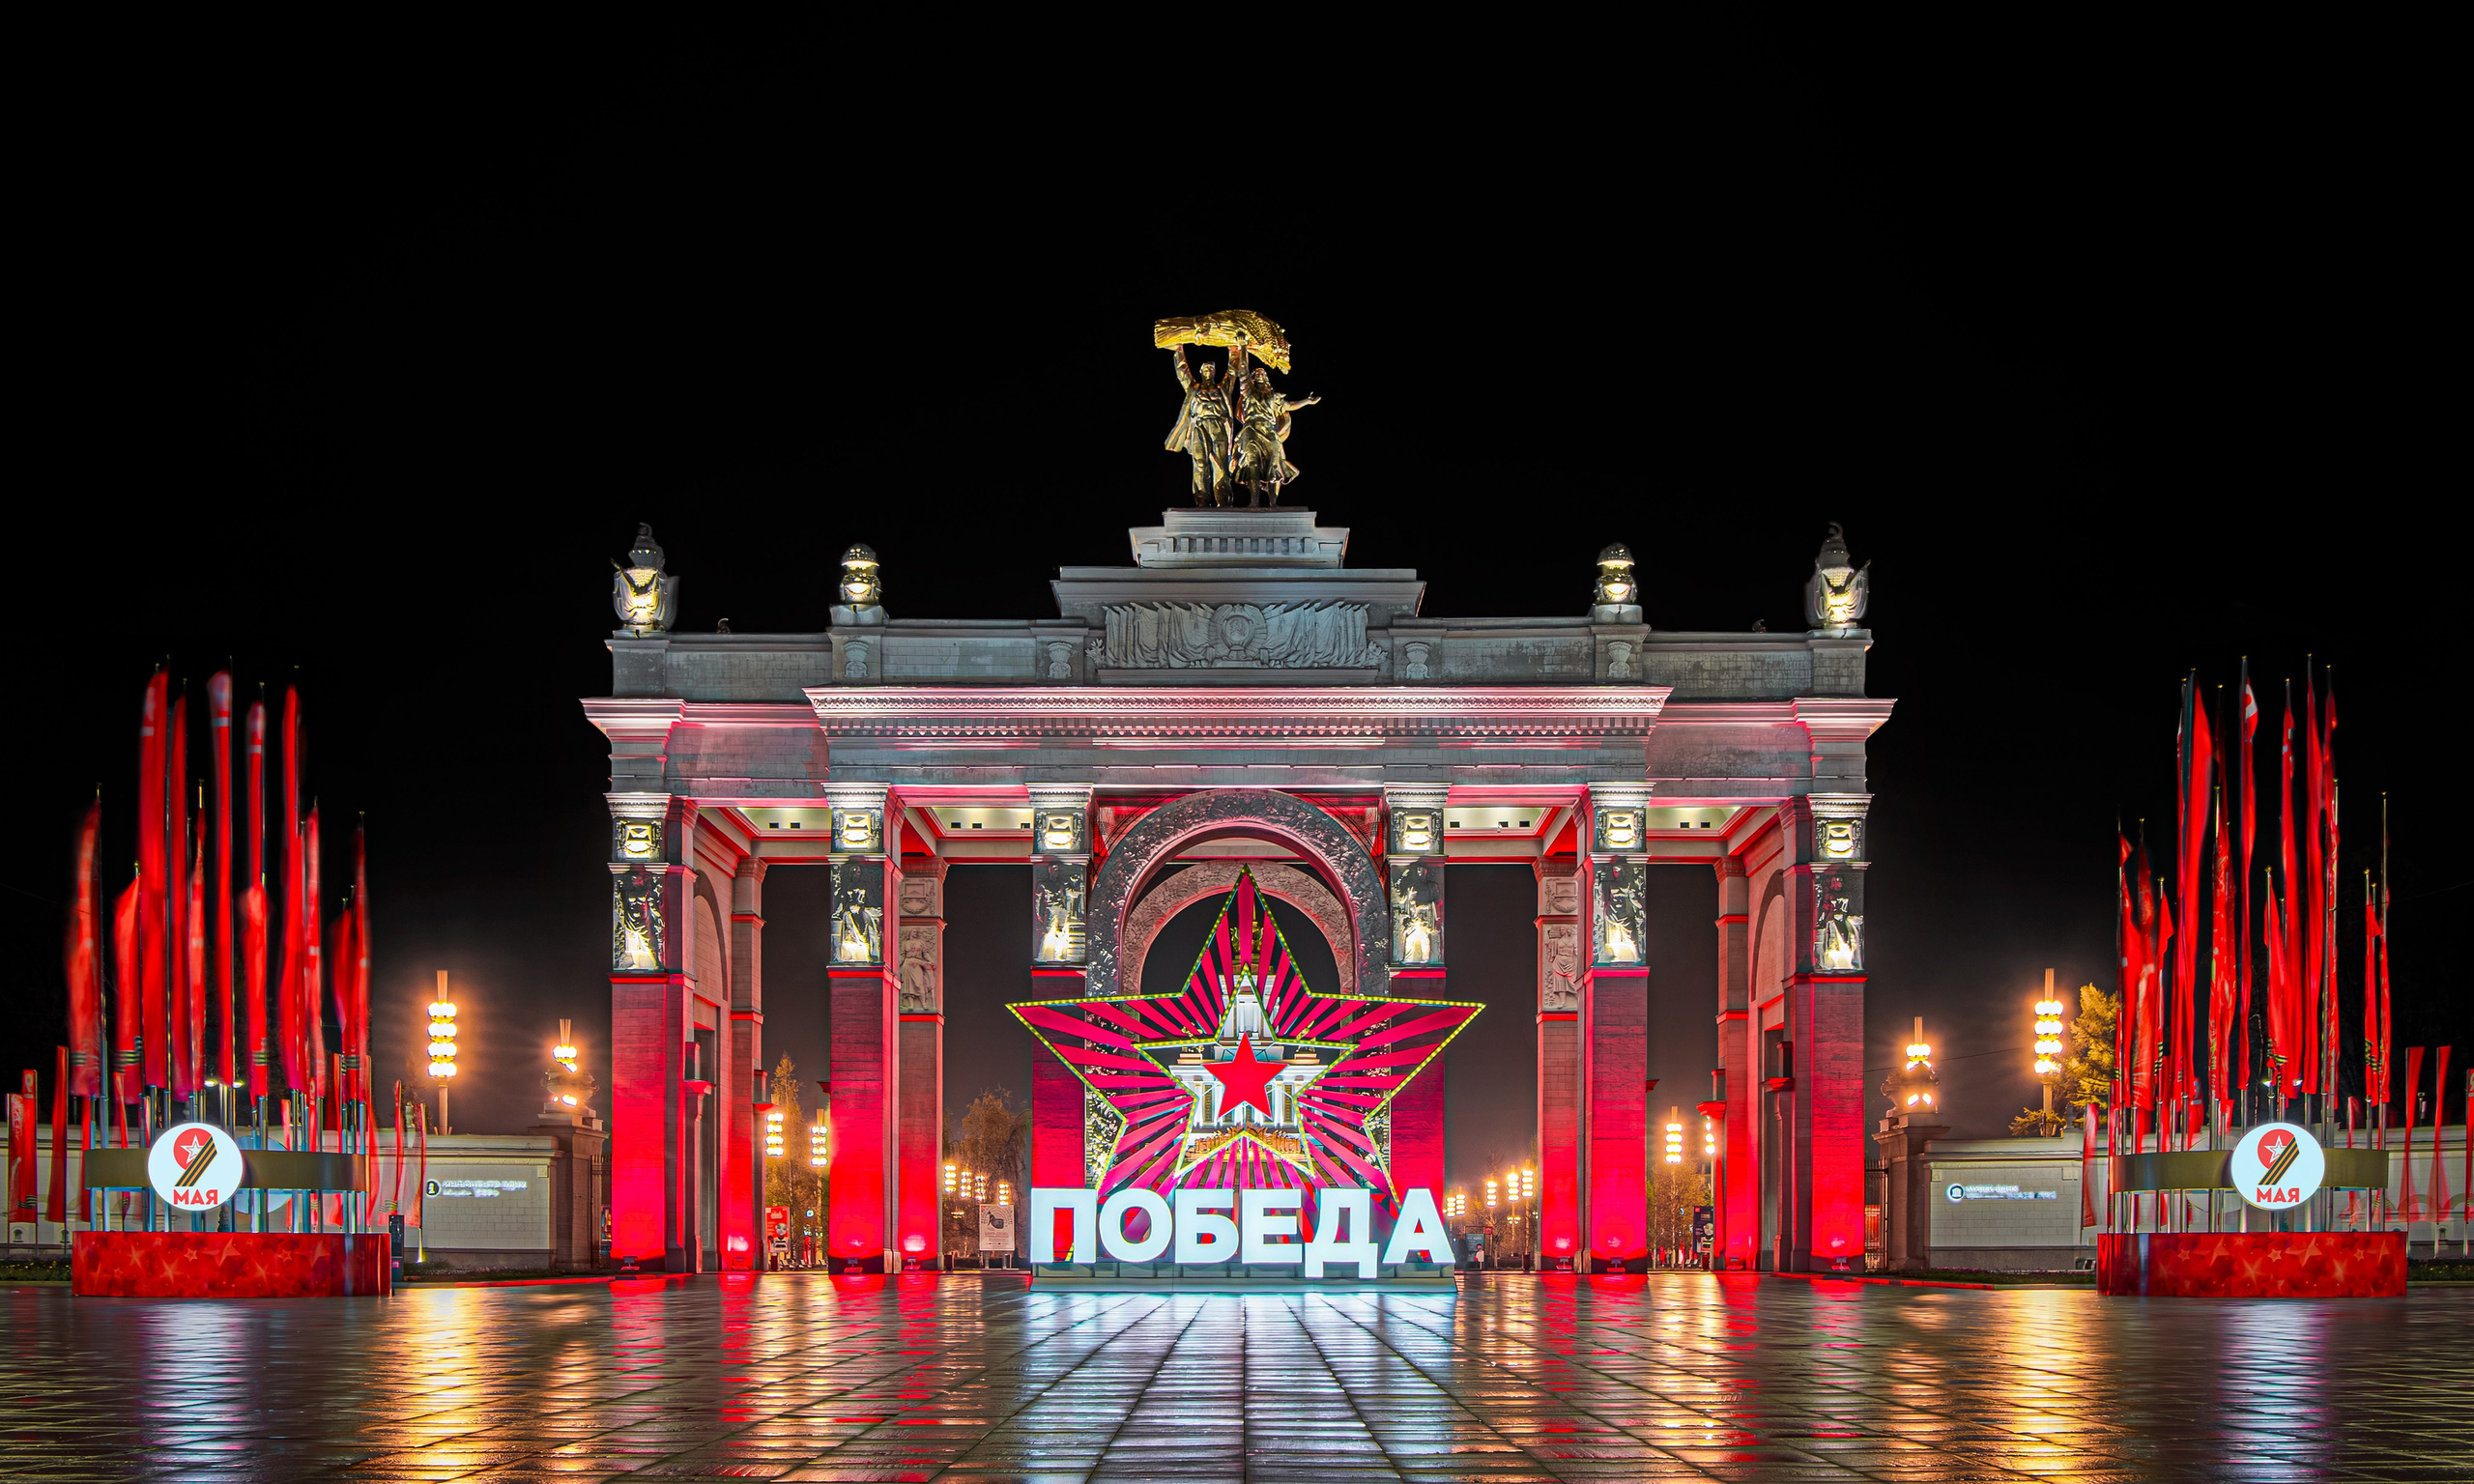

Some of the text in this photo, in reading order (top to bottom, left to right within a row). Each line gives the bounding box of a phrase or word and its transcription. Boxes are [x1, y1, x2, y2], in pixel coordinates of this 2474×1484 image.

[173, 1127, 217, 1187] 9
[2257, 1128, 2300, 1185] 9
[173, 1188, 218, 1205] МАЯ
[2257, 1187, 2300, 1203] МАЯ
[1030, 1187, 1456, 1278] ПОБЕДА
